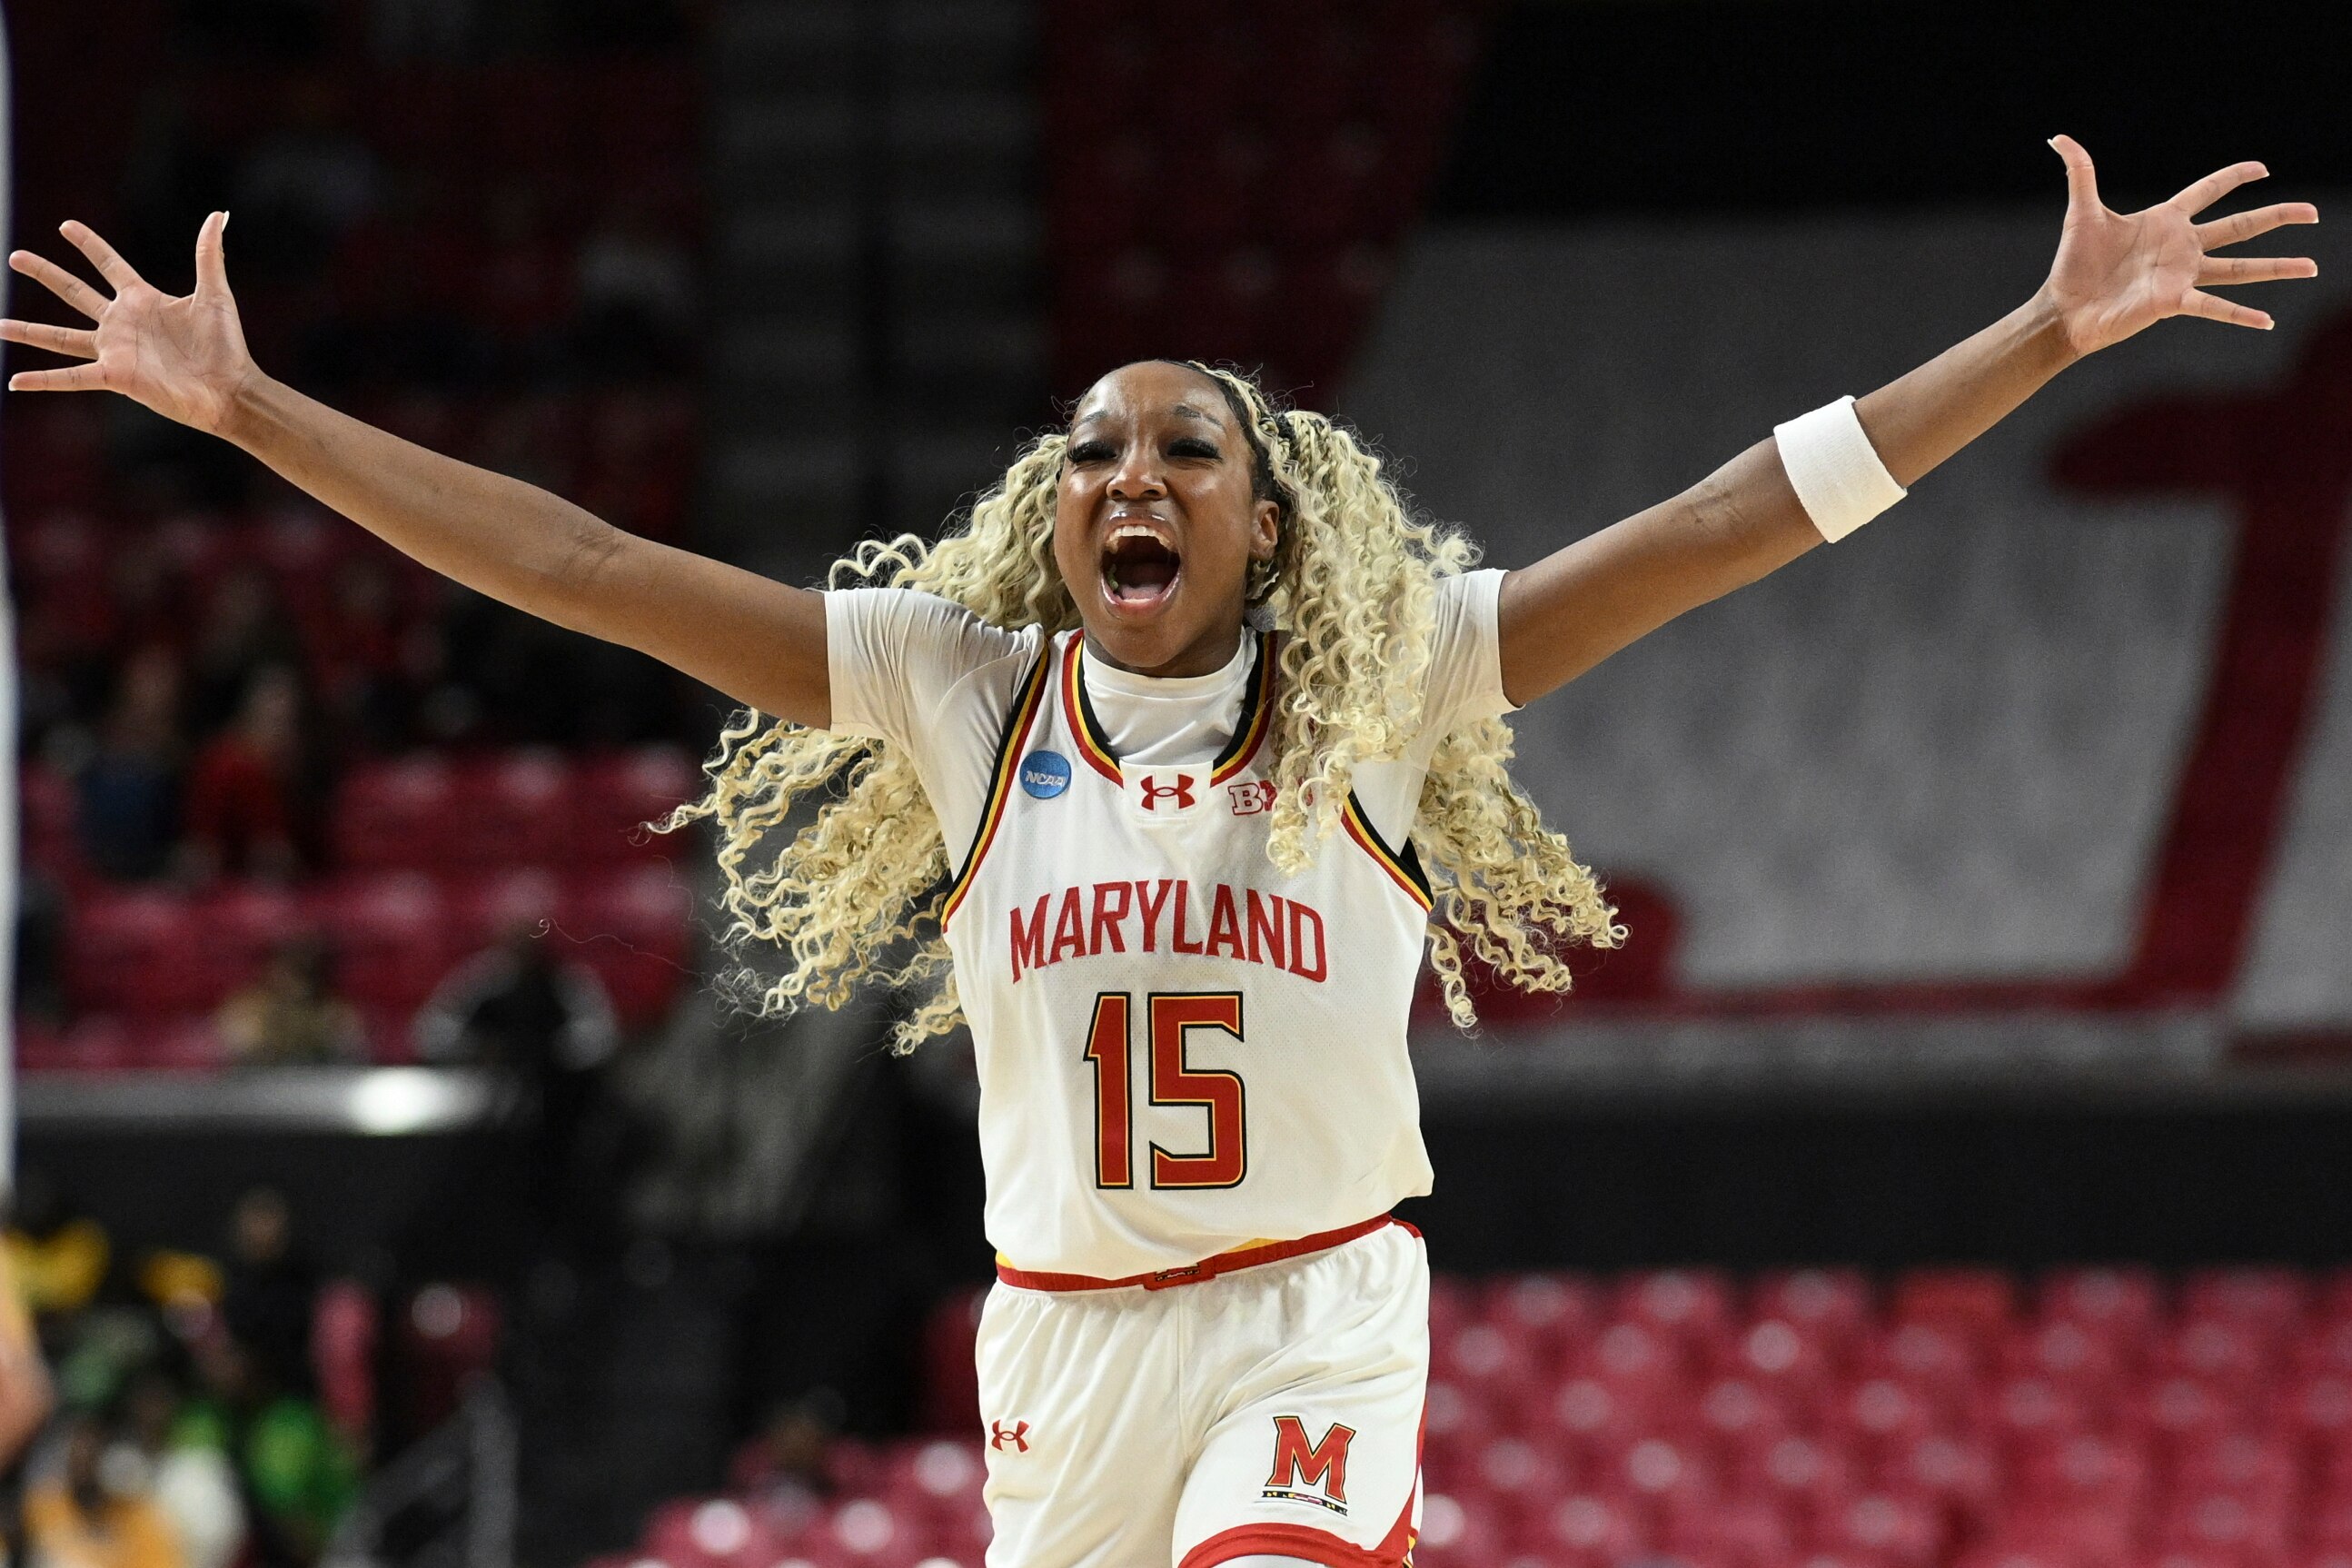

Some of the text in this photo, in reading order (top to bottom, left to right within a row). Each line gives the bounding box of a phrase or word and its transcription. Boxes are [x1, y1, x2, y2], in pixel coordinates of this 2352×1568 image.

[1025, 769, 1066, 789] NCAA
[1010, 878, 1328, 984] MARYLAND
[1083, 991, 1247, 1190] 15
[1265, 1415, 1356, 1505] M
